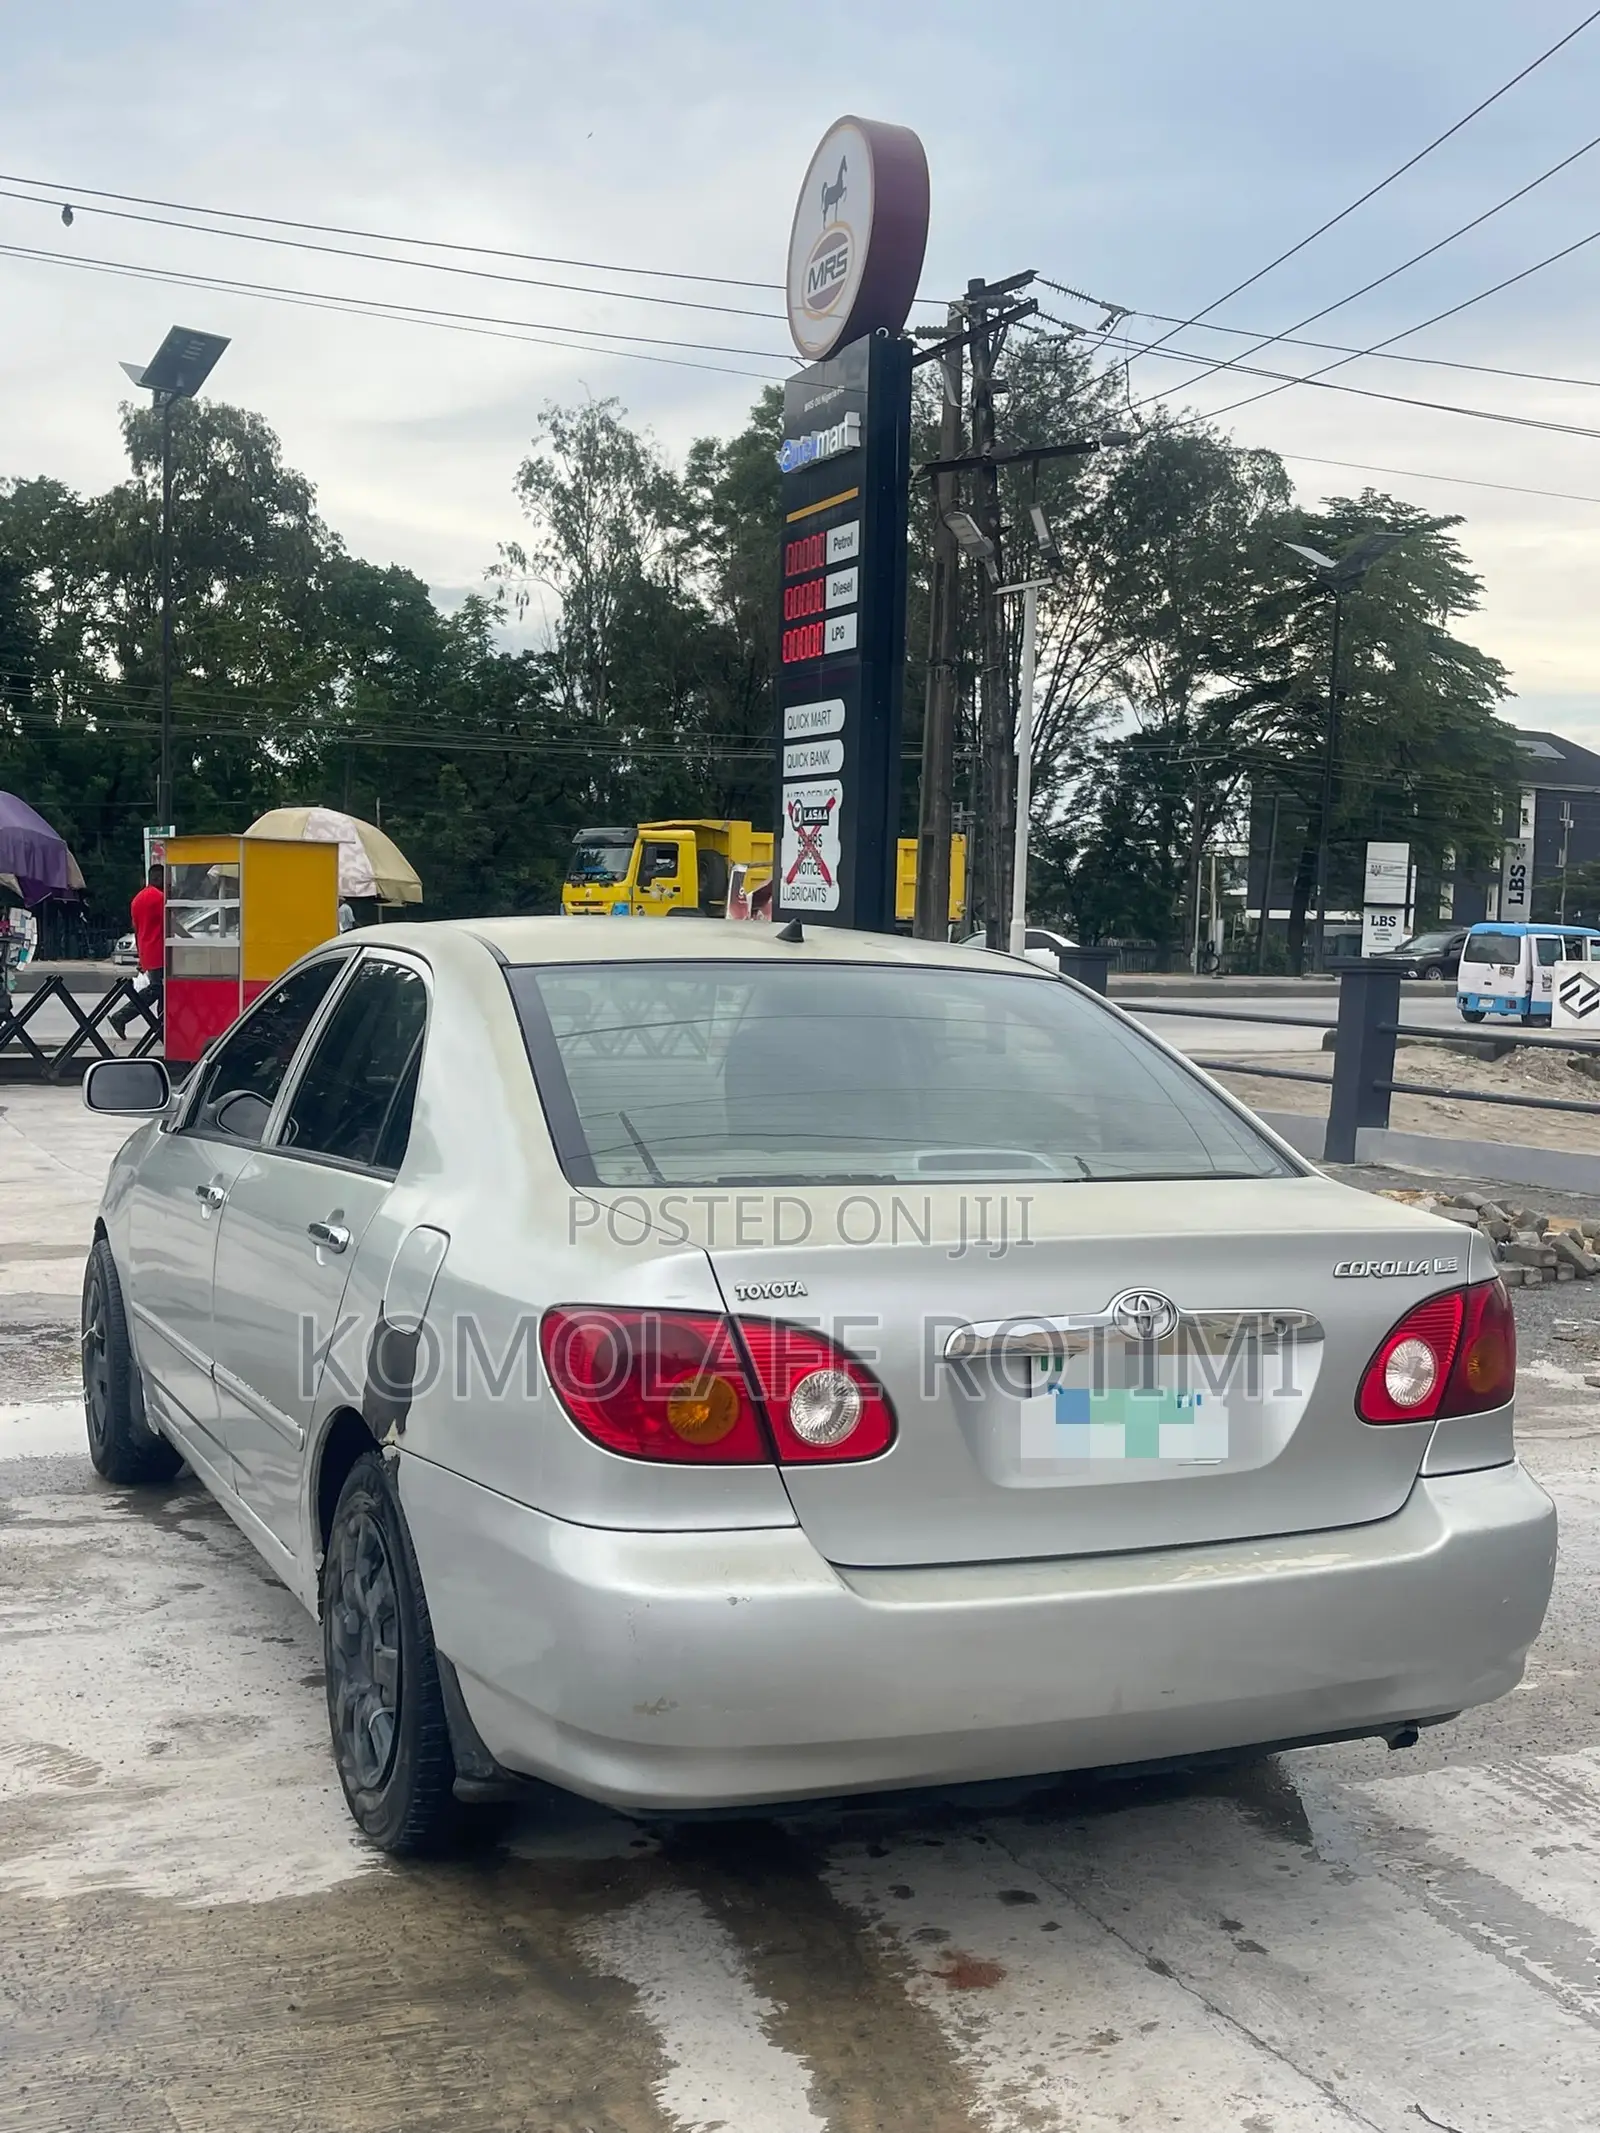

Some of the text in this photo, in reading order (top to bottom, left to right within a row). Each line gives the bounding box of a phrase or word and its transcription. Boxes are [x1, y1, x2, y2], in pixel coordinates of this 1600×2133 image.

[807, 247, 848, 294] MRS
[833, 532, 853, 551] Petrol
[832, 578, 853, 597] Diesel
[831, 625, 845, 642] LPG
[787, 709, 832, 731] QUICK MART
[786, 748, 831, 769] QUICK BANK
[803, 809, 828, 820] LASAA
[1508, 864, 1526, 905] LBS
[782, 886, 827, 904] LUBRICANTS
[1371, 915, 1397, 927] LBS
[1333, 1256, 1458, 1278] COROLLA LE
[735, 1280, 808, 1301] TOYOTA
